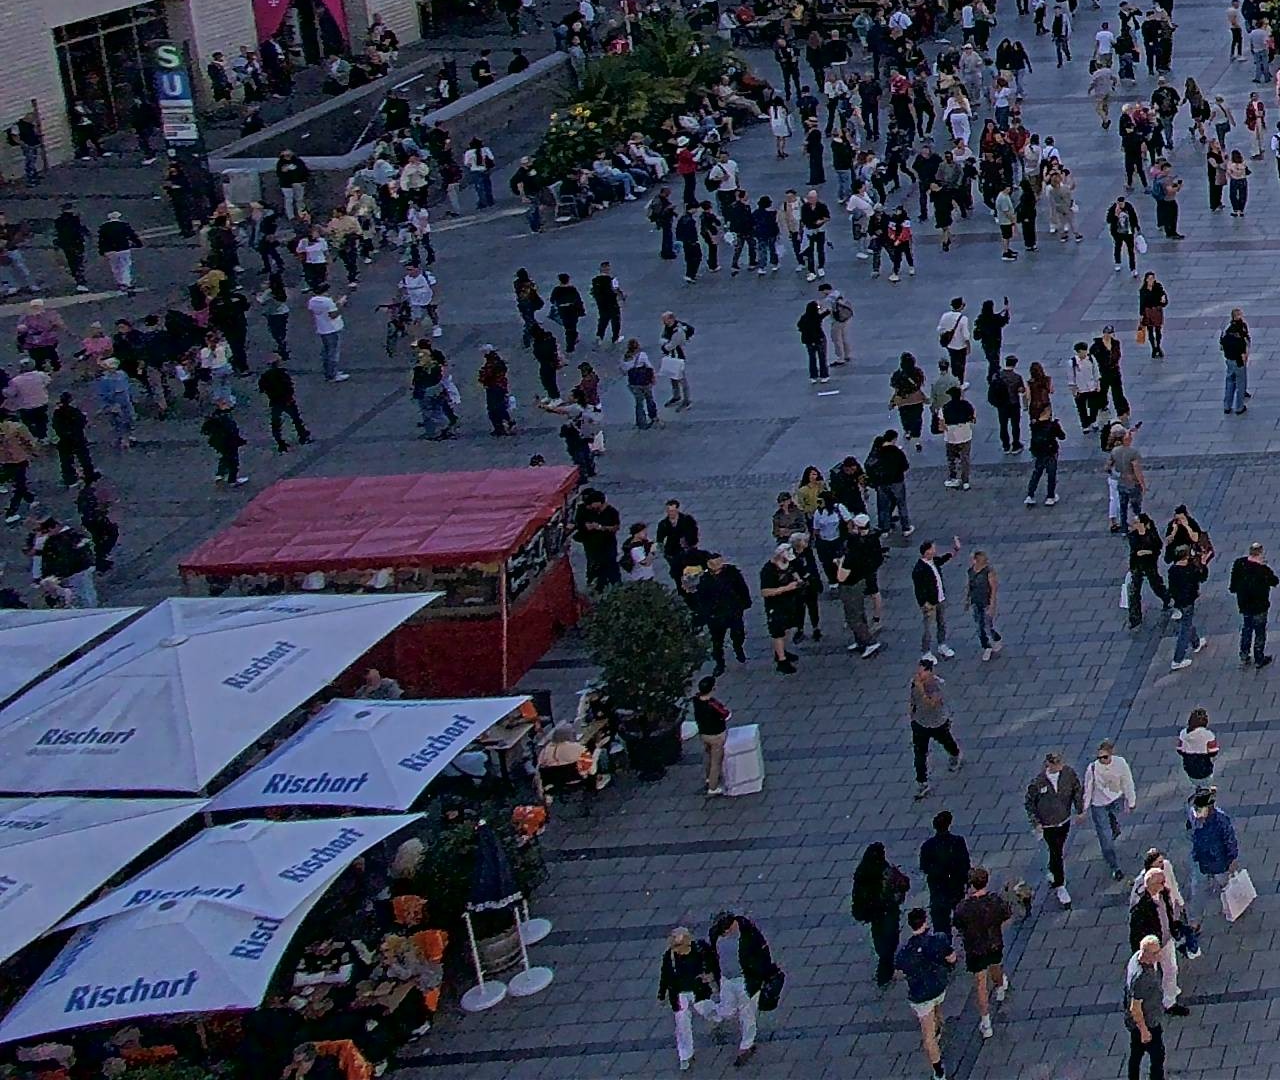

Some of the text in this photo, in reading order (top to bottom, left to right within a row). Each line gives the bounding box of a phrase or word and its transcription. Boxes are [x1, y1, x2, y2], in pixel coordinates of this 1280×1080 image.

[158, 46, 180, 69] S
[162, 74, 182, 97] U
[222, 641, 296, 689] Rischart
[35, 726, 137, 746] Rischart
[399, 714, 476, 772] Rischart
[262, 772, 369, 794] Rischart
[278, 827, 364, 883] Rischart
[64, 970, 199, 1013] Rischart
